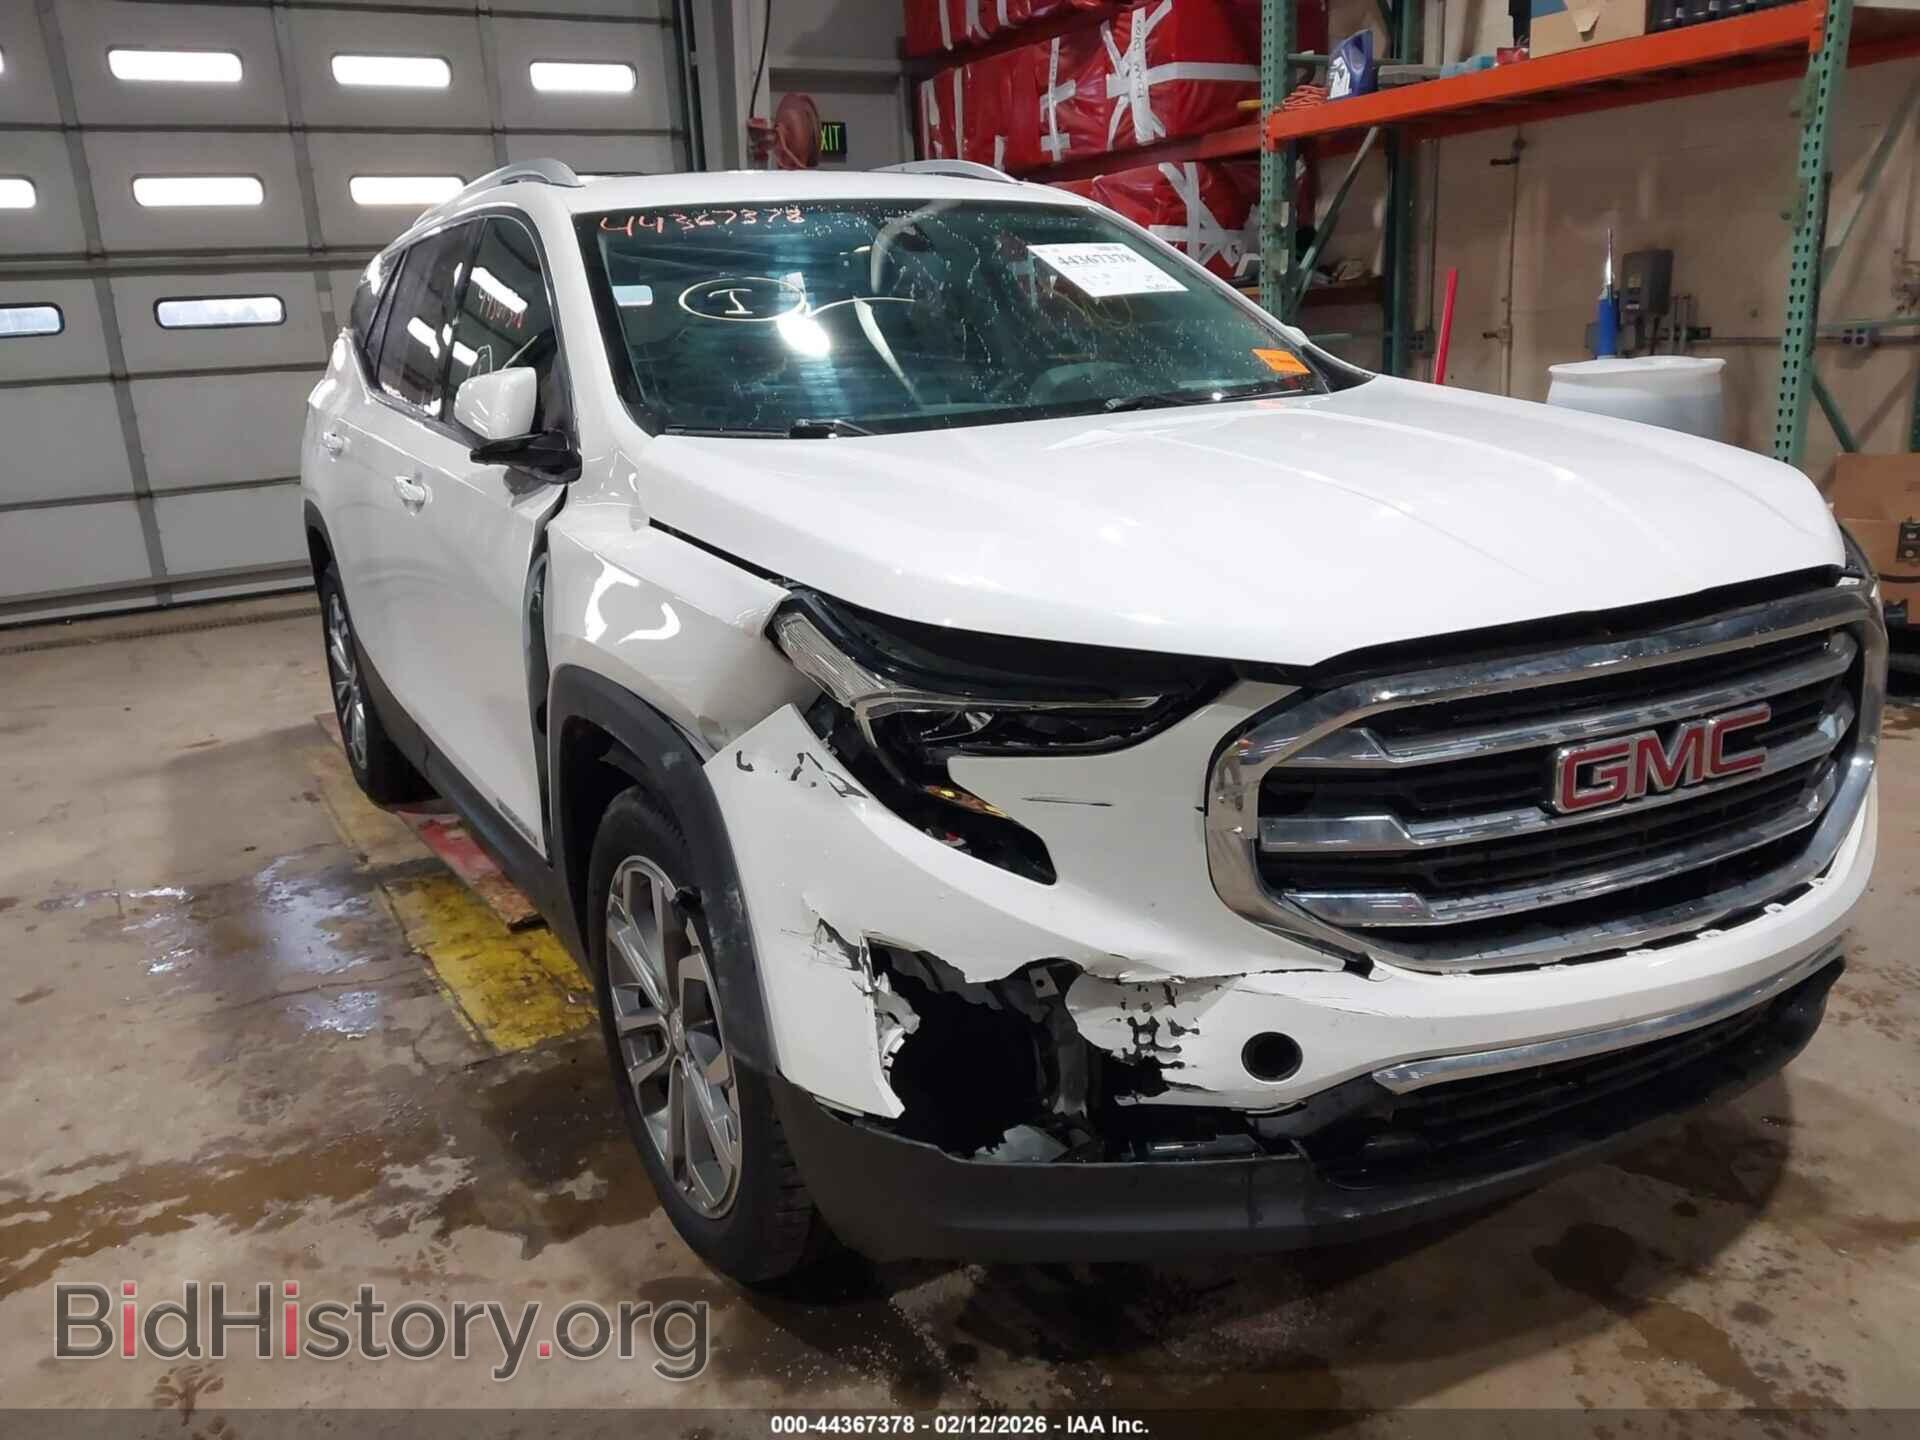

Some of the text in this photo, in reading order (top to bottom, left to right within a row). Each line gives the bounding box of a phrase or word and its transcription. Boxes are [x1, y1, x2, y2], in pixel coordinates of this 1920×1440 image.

[820, 125, 841, 151] XIT
[600, 208, 805, 237] 44367378
[1056, 253, 1137, 266] 44367378
[1554, 702, 1773, 814] GMC
